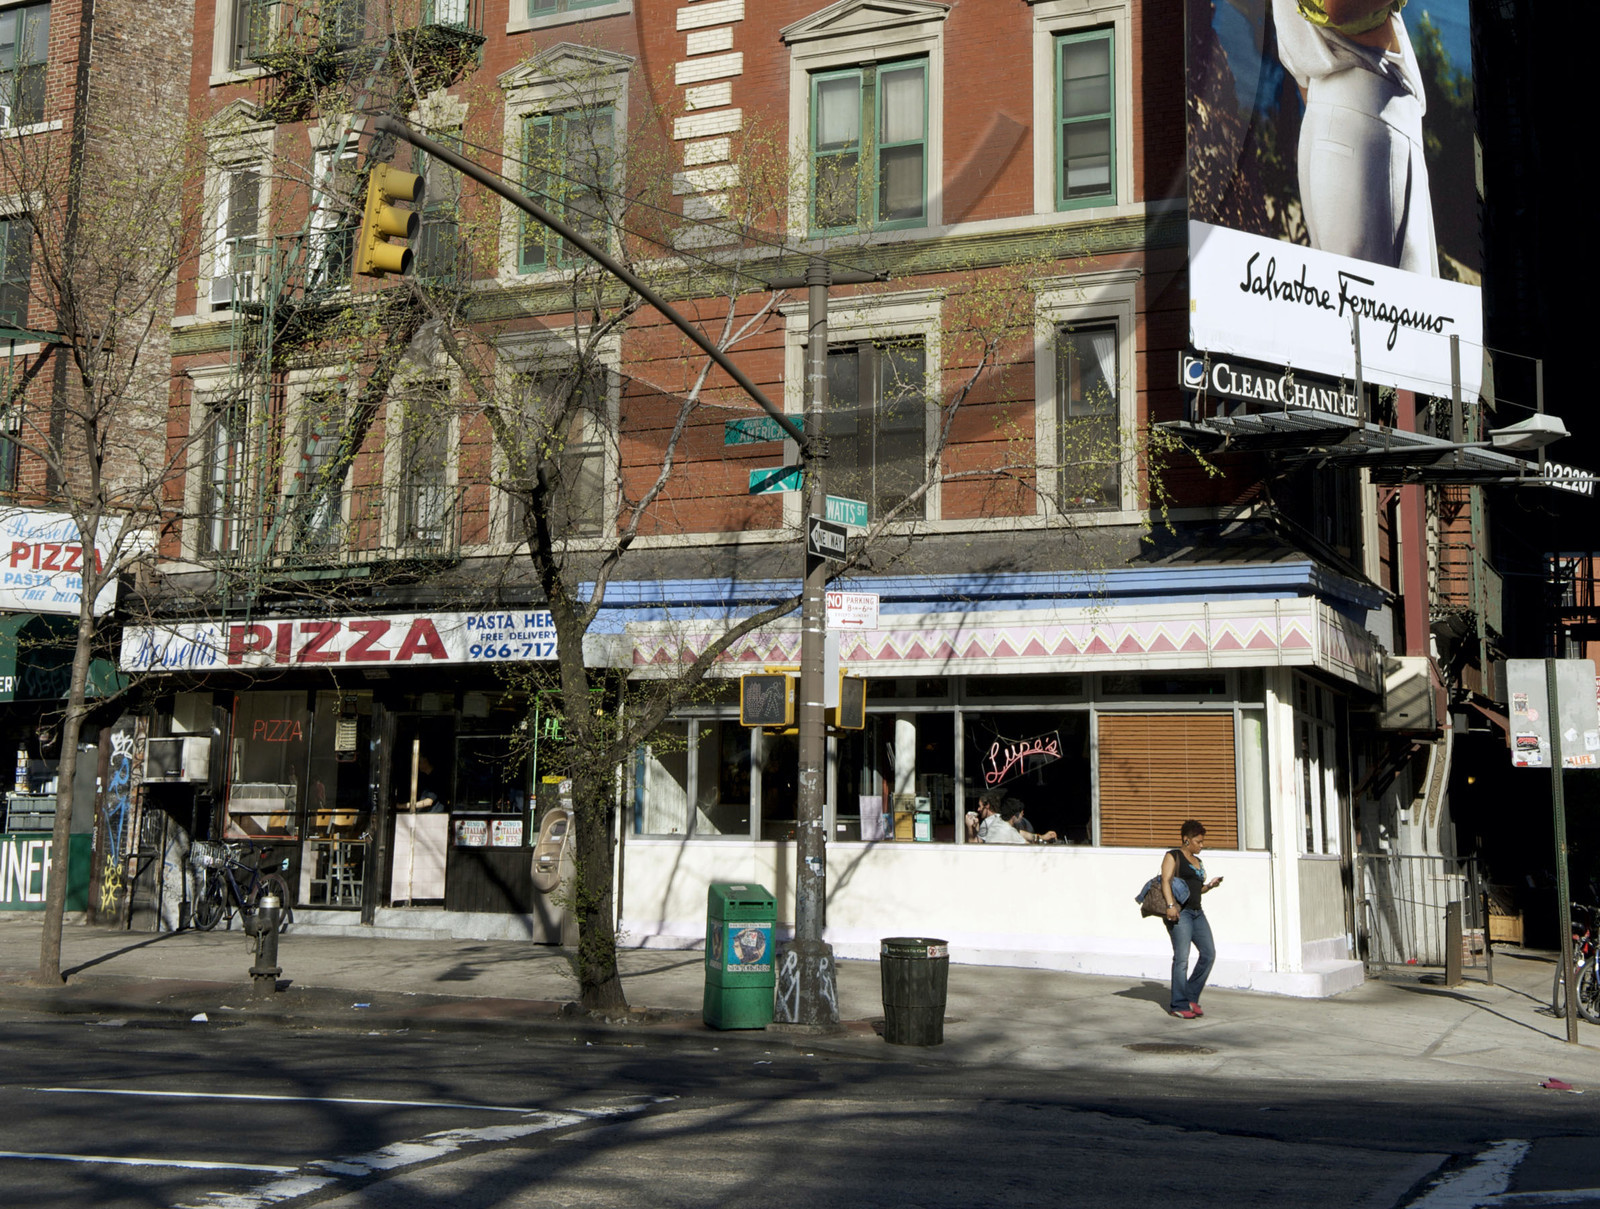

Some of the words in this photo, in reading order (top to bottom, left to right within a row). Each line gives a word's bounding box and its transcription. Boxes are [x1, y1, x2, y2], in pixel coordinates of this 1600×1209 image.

[1240, 252, 1336, 310] Salvatore
[1337, 270, 1455, 352] Ferragamo
[1544, 461, 1594, 495] 022201
[826, 499, 856, 524] WATTS
[857, 505, 866, 517] ST
[814, 529, 826, 546] ONE
[830, 536, 844, 550] WAY
[4, 573, 52, 587] PASTA
[22, 589, 47, 600] FREE
[828, 594, 842, 608] NO
[846, 597, 875, 605] PARKING
[467, 614, 515, 630] PASTA
[524, 613, 555, 628] HER
[228, 618, 450, 665] PIZZA
[480, 632, 504, 641] FREE
[509, 630, 557, 640] DELIVERY
[469, 642, 560, 659] 966-717
[253, 719, 303, 741] PIZZA
[985, 737, 1061, 783] Lupe's
